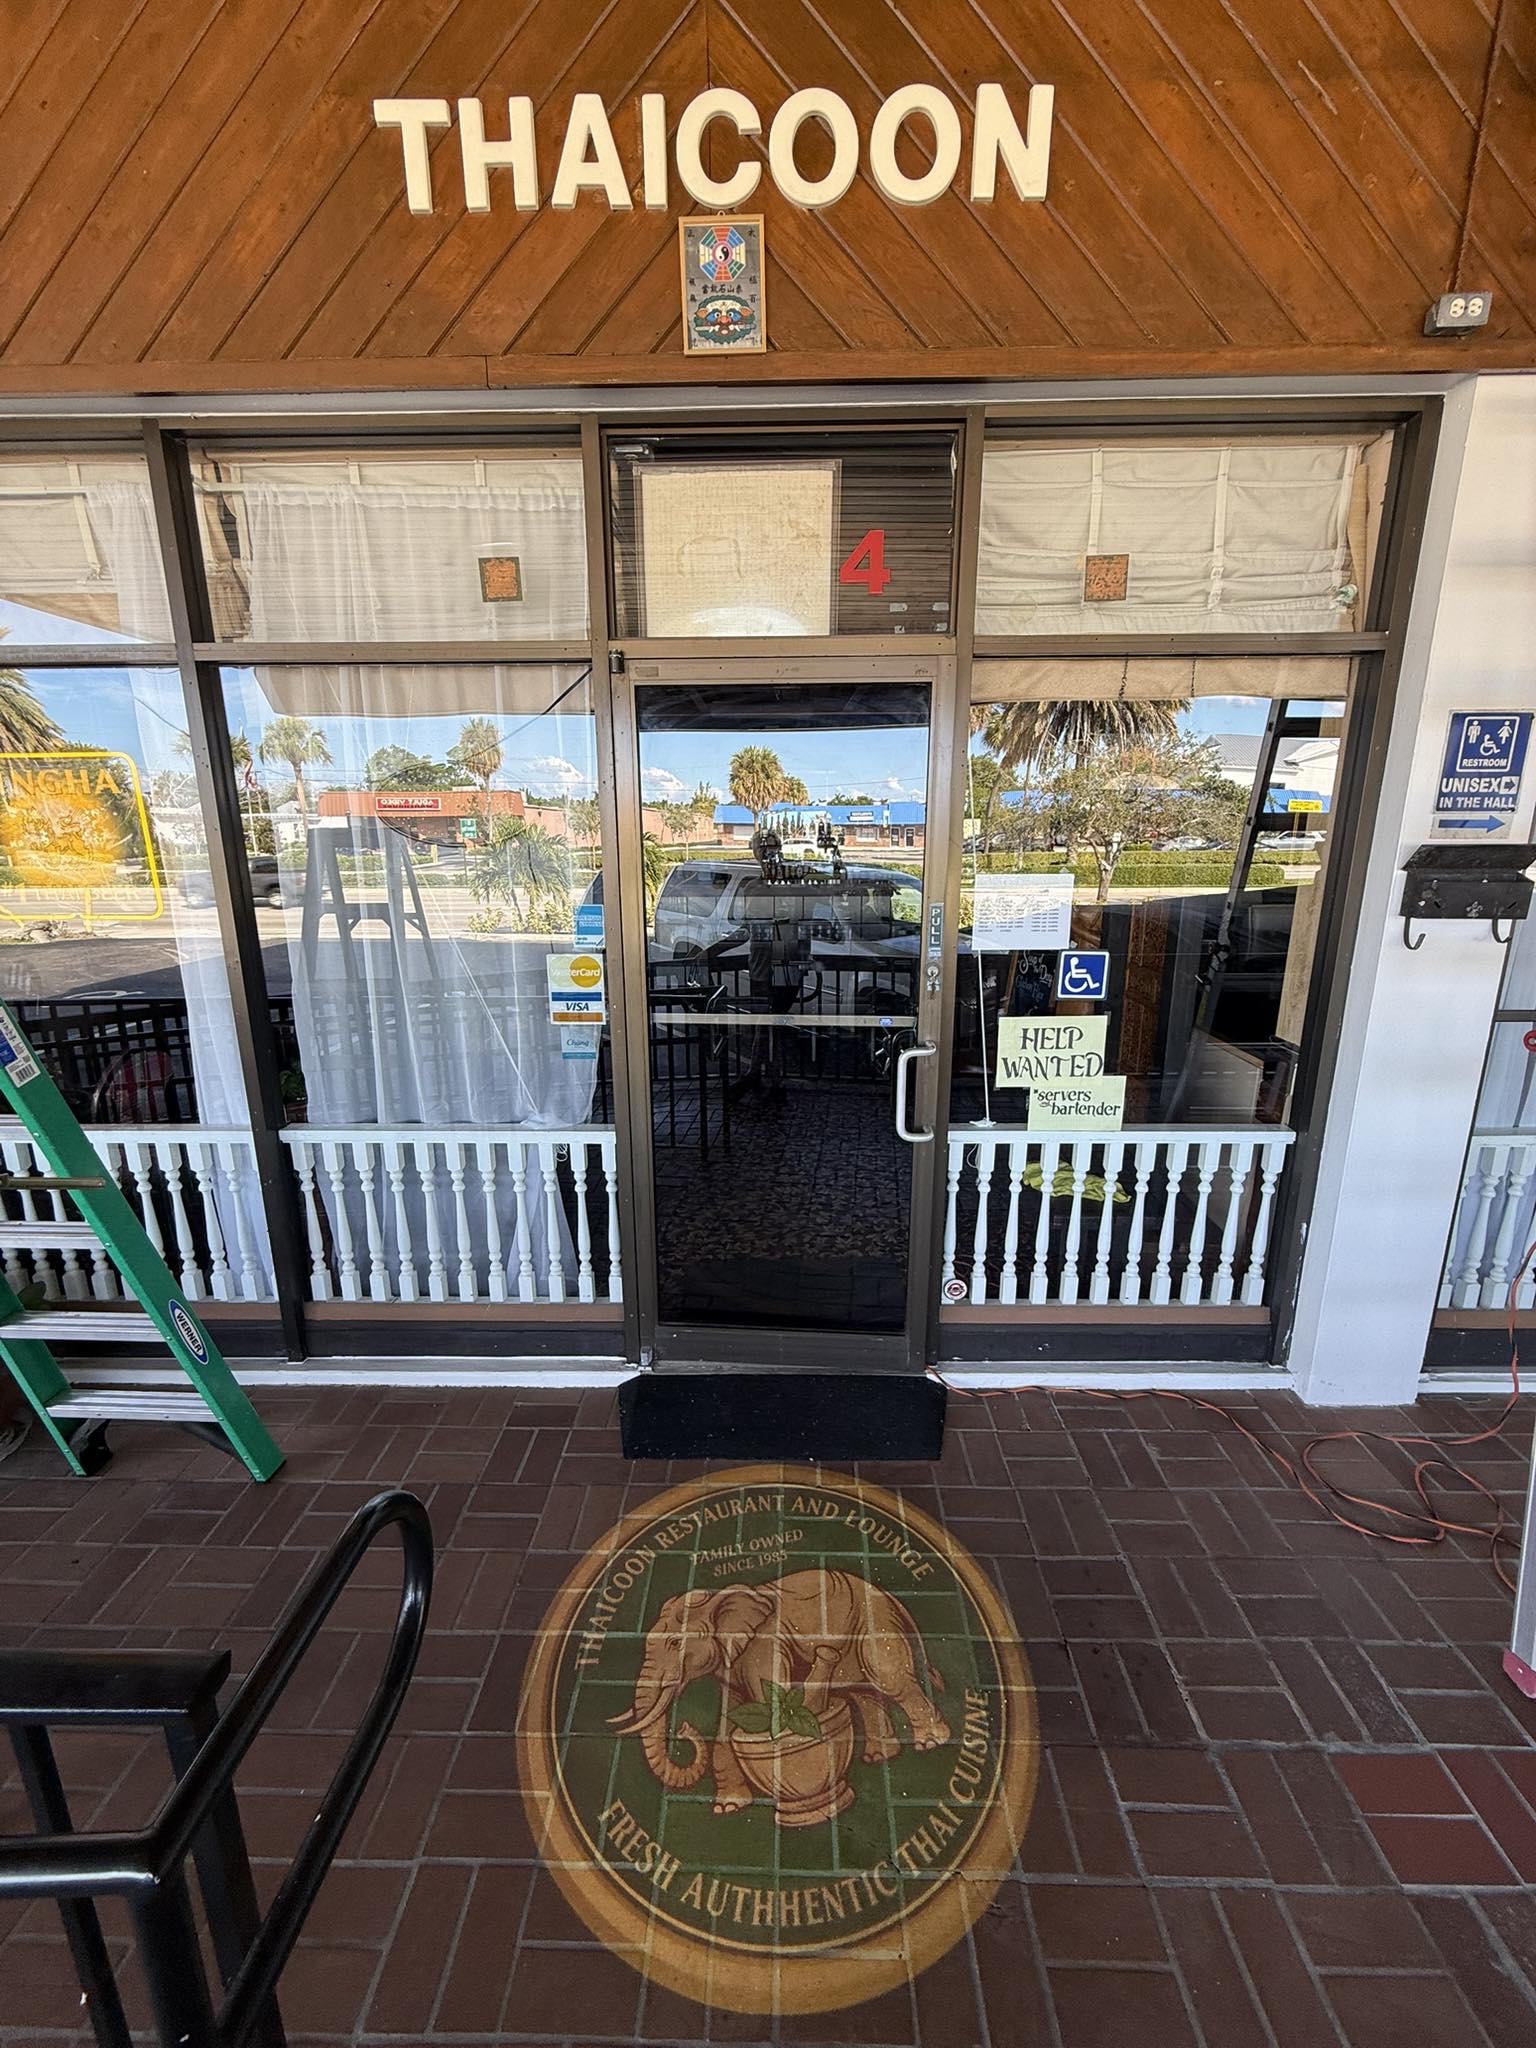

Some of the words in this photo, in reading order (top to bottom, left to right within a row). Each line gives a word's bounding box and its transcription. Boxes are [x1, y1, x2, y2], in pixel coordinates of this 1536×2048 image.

[372, 82, 1056, 215] THAICOON
[839, 528, 892, 595] 4
[1461, 757, 1508, 768] RESTROOM
[1440, 777, 1502, 794] UNISEX
[1439, 797, 1452, 808] IN
[1456, 797, 1481, 808] THE
[1483, 797, 1515, 808] HALL
[931, 908, 941, 945] PULL
[565, 1002, 590, 1012] VISA
[1019, 1026, 1084, 1054] HELP
[1001, 1051, 1104, 1082] WANTED
[1051, 1101, 1121, 1117] bartender
[176, 1312, 202, 1353] WERNER
[690, 1541, 745, 1567] FAMILY
[748, 1528, 804, 1552] OWNED
[713, 1556, 755, 1577] SINCE
[575, 1544, 658, 1671] THAICOON
[654, 1494, 785, 1551] RESTAURANT
[792, 1496, 841, 1521] AND
[845, 1509, 937, 1583] LOUNGE
[597, 1797, 678, 1893] FRESH
[681, 1859, 898, 1928] AUTHHENTIC
[896, 1807, 964, 1878] THAI
[949, 1686, 991, 1807] CUISINE
